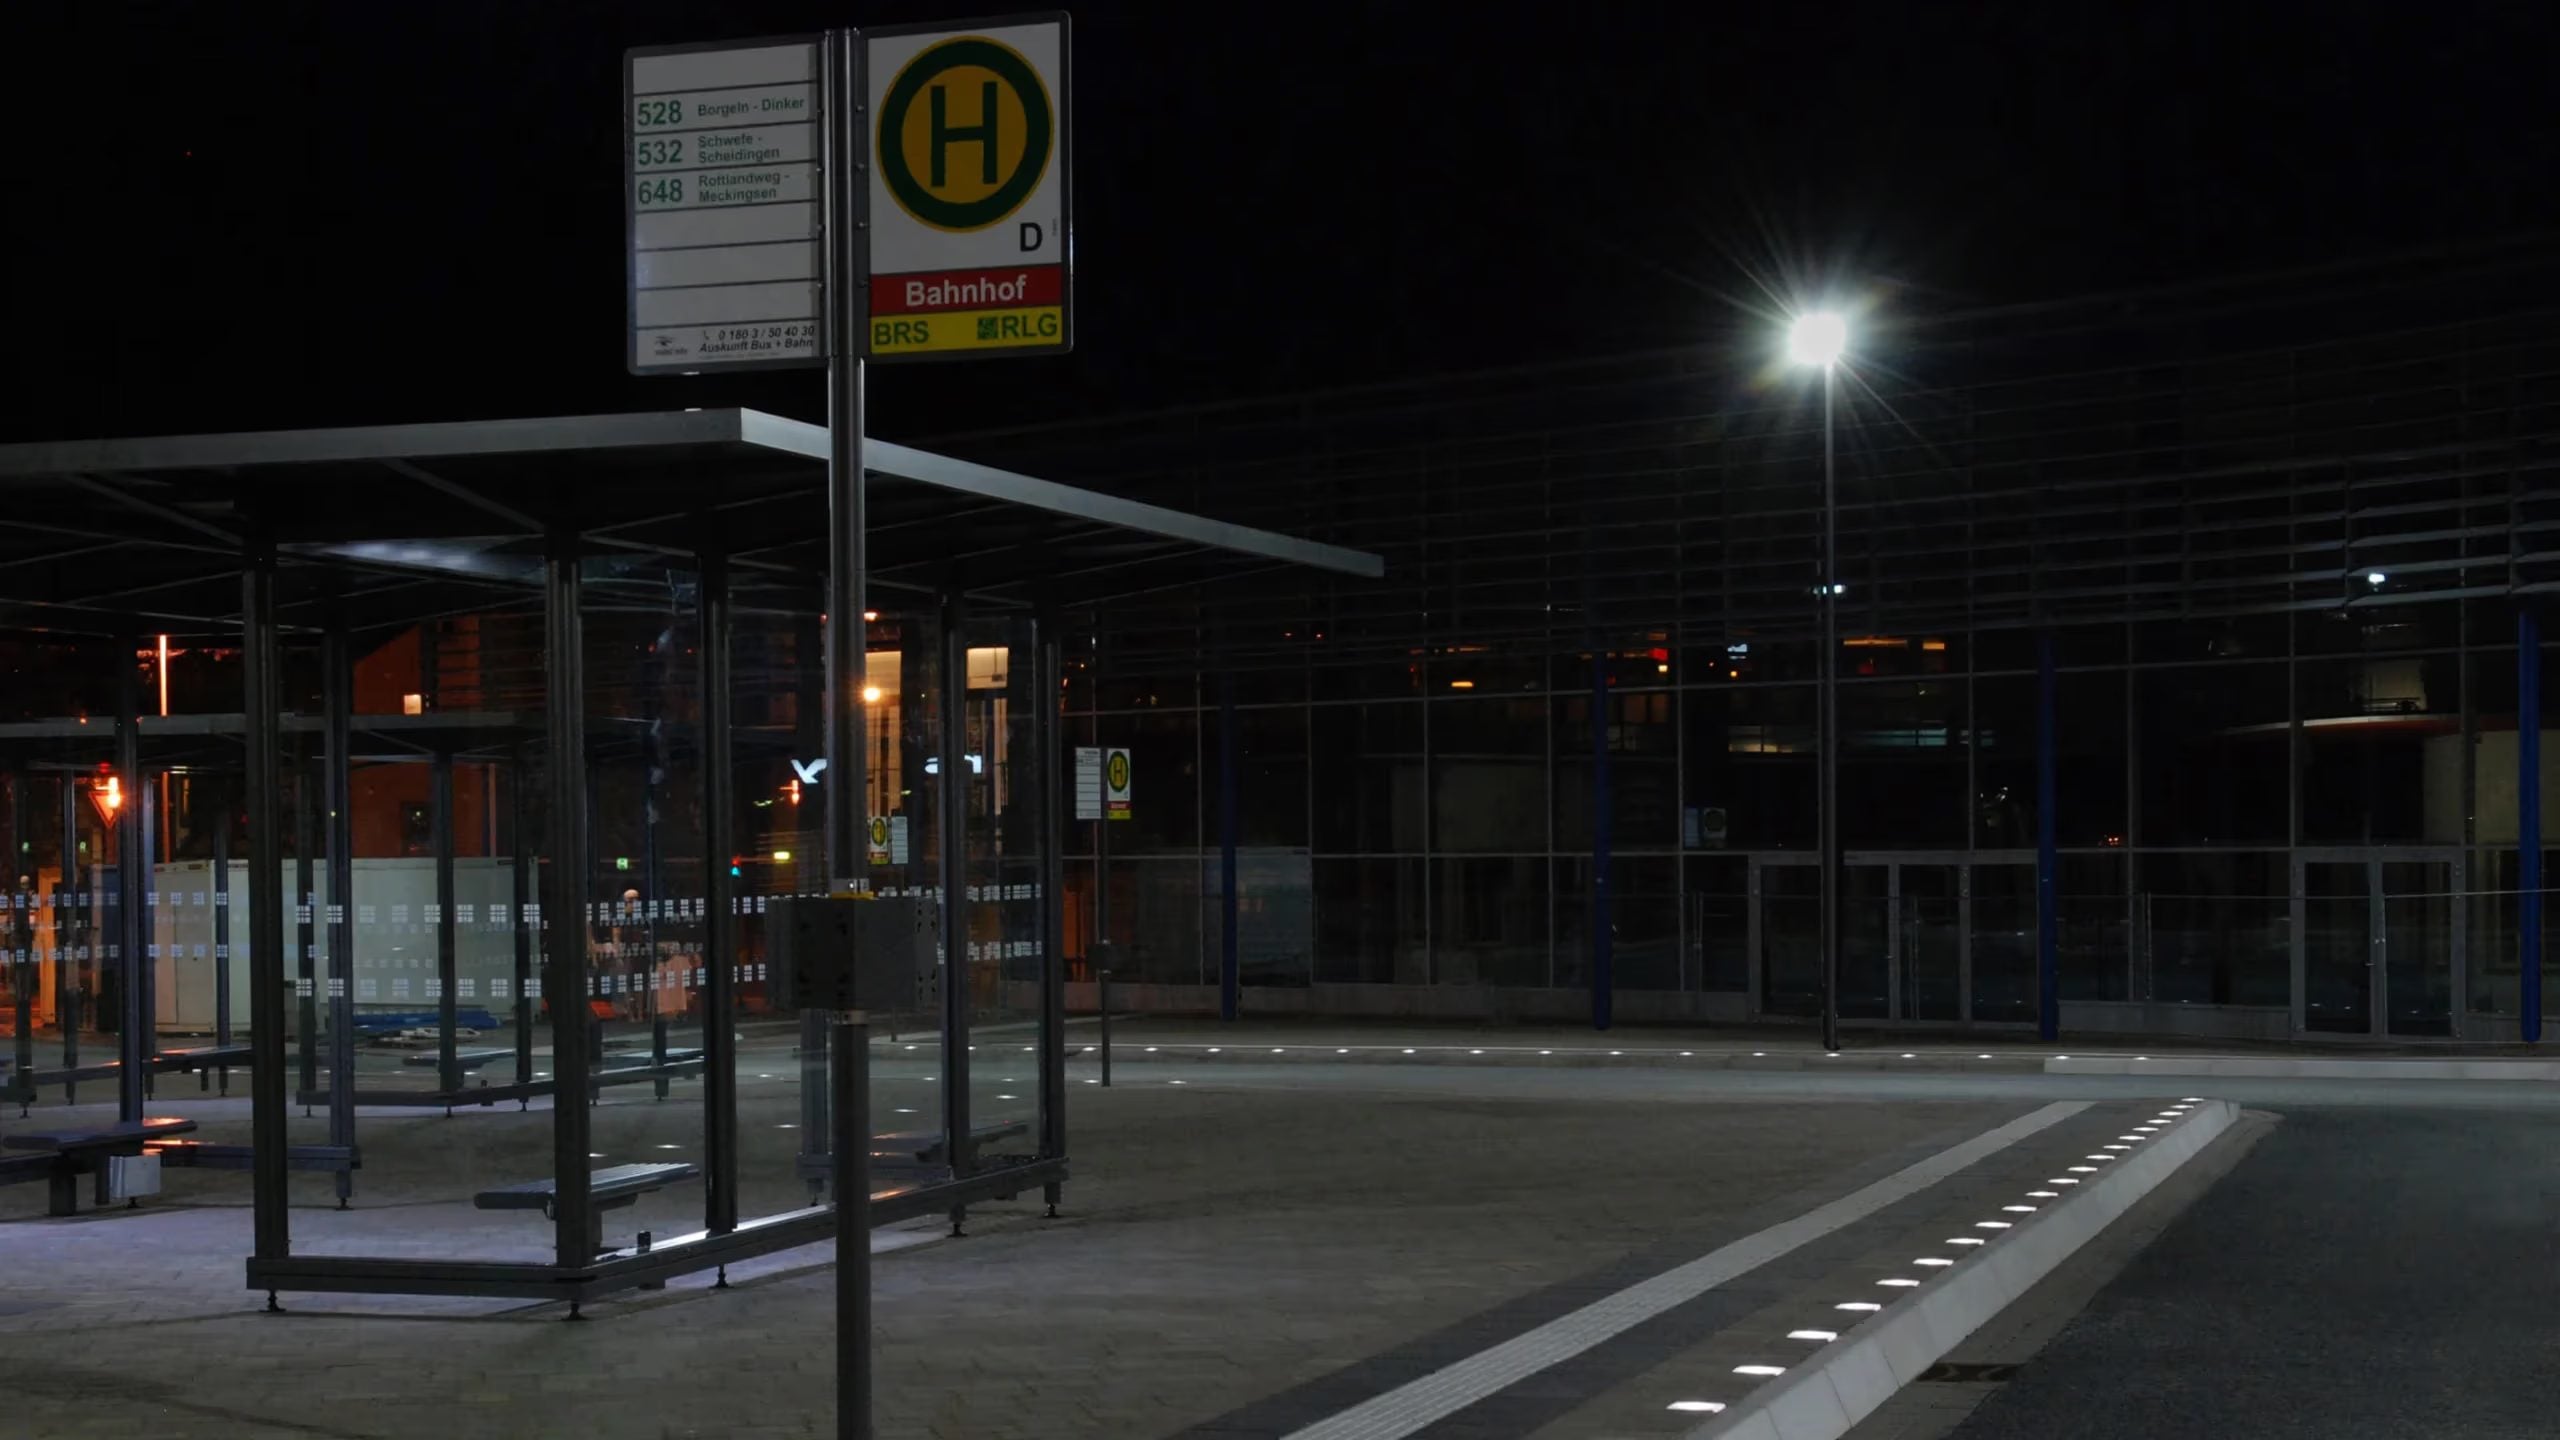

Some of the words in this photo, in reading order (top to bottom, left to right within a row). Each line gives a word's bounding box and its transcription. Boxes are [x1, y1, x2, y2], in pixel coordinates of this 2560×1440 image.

[637, 100, 683, 126] 528
[698, 102, 749, 117] Borgeln
[761, 98, 805, 112] Dinker
[698, 134, 753, 148] Schwefe
[930, 81, 998, 187] H
[638, 139, 683, 165] 532
[698, 149, 780, 164] Scheidingen
[638, 179, 683, 205] 648
[698, 172, 781, 187] Rottlandweg
[699, 187, 777, 203] Meckingsen
[1020, 222, 1043, 252] D
[905, 274, 1028, 307] Bahnhof
[730, 329, 749, 340] 180
[768, 327, 782, 338] 50
[785, 326, 799, 337] 40
[874, 320, 929, 345] BRS
[1002, 313, 1058, 338] RLG
[700, 340, 748, 353] Auskunft
[751, 339, 772, 351] Bus
[785, 337, 815, 349] Bahn
